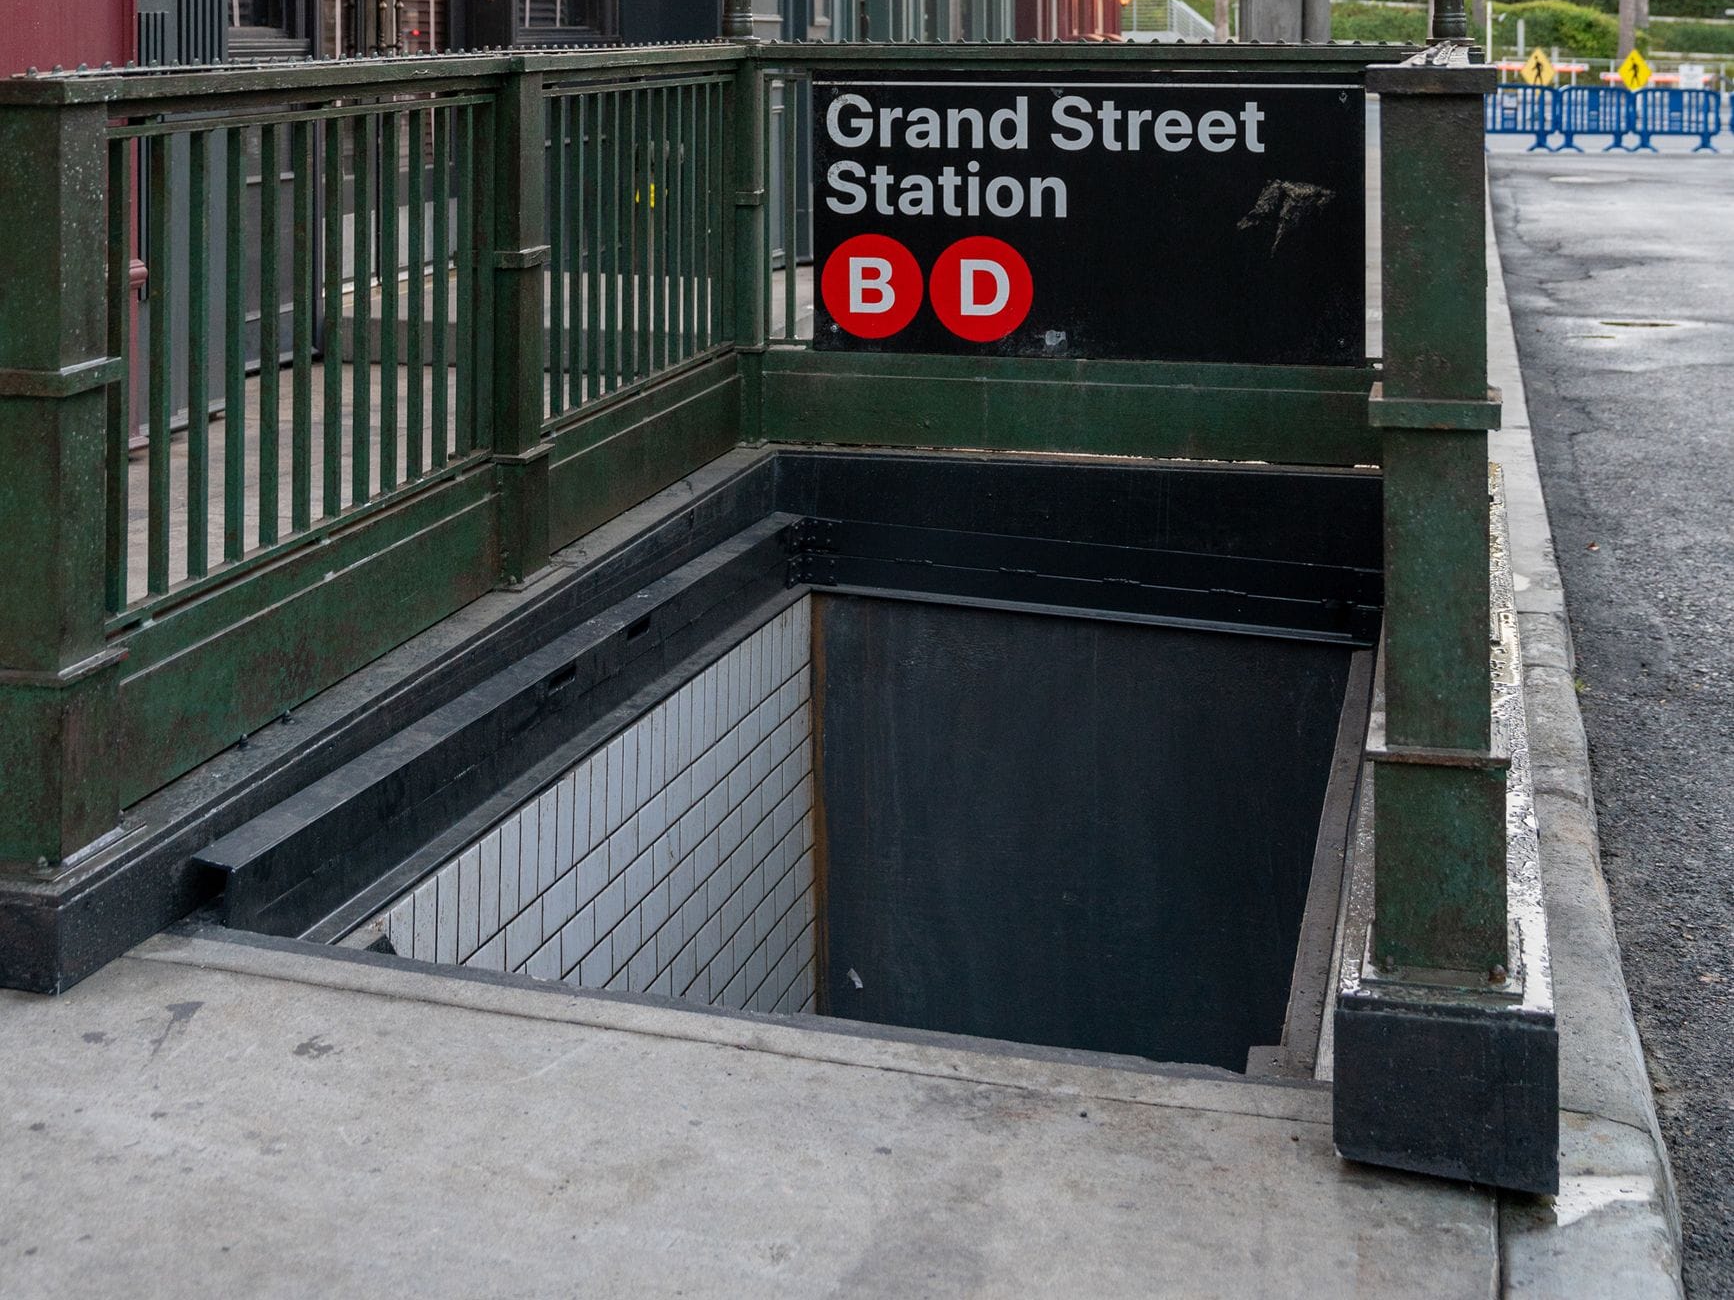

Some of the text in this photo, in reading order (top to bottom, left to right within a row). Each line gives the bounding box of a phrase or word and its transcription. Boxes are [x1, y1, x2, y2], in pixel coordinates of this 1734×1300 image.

[826, 93, 1266, 153] Grand Street
[825, 159, 1068, 218] Station
[848, 256, 1011, 317] B D
